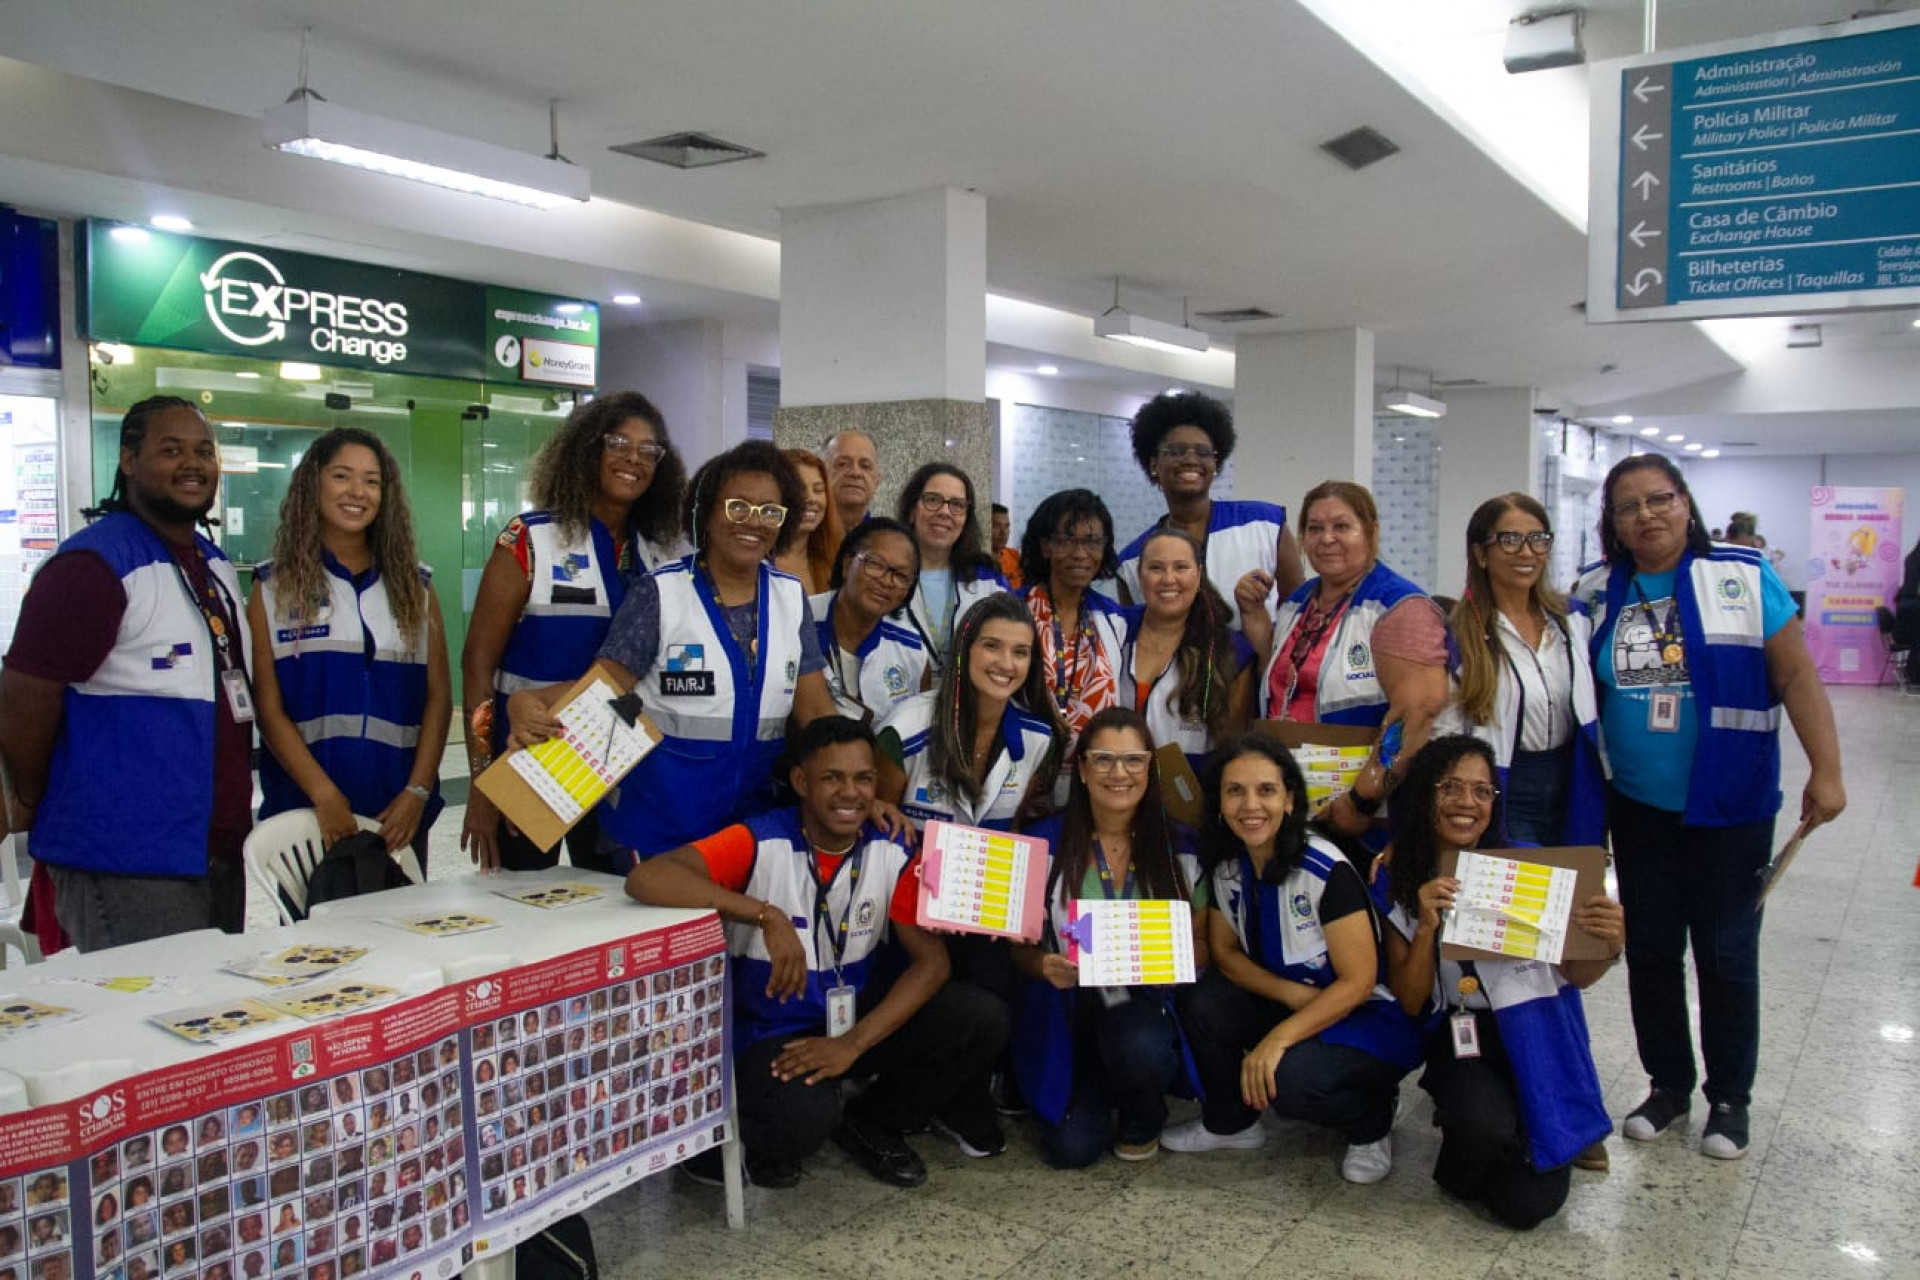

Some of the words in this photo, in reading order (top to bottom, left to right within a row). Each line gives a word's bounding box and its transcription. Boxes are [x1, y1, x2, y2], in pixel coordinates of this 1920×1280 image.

[1694, 75, 1789, 97] Administration
[1797, 61, 1902, 84] Administración
[1695, 54, 1816, 80] Administração
[1694, 112, 1749, 130] Polícia
[1753, 105, 1811, 124] Militar
[1694, 130, 1749, 146] Military
[1748, 126, 1789, 140] Police
[1848, 114, 1897, 128] Militar
[1693, 159, 1777, 179] Sanitários
[1692, 178, 1762, 195] Restrooms
[1771, 174, 1816, 188] Baños
[1689, 212, 1731, 229] Casa
[1735, 208, 1760, 226] de
[1763, 202, 1837, 223] Câmbio
[1691, 228, 1761, 245] Exchange
[1765, 224, 1814, 239] House
[1688, 256, 1785, 277] Bilheterias
[1690, 279, 1731, 293] Ticket
[1734, 275, 1786, 291] Offices
[1798, 270, 1866, 287] Taquillas
[221, 277, 408, 336] EXPRESS
[310, 326, 407, 364] Change
[666, 677, 706, 692] FIA/RJ
[79, 1089, 126, 1126] SOS
